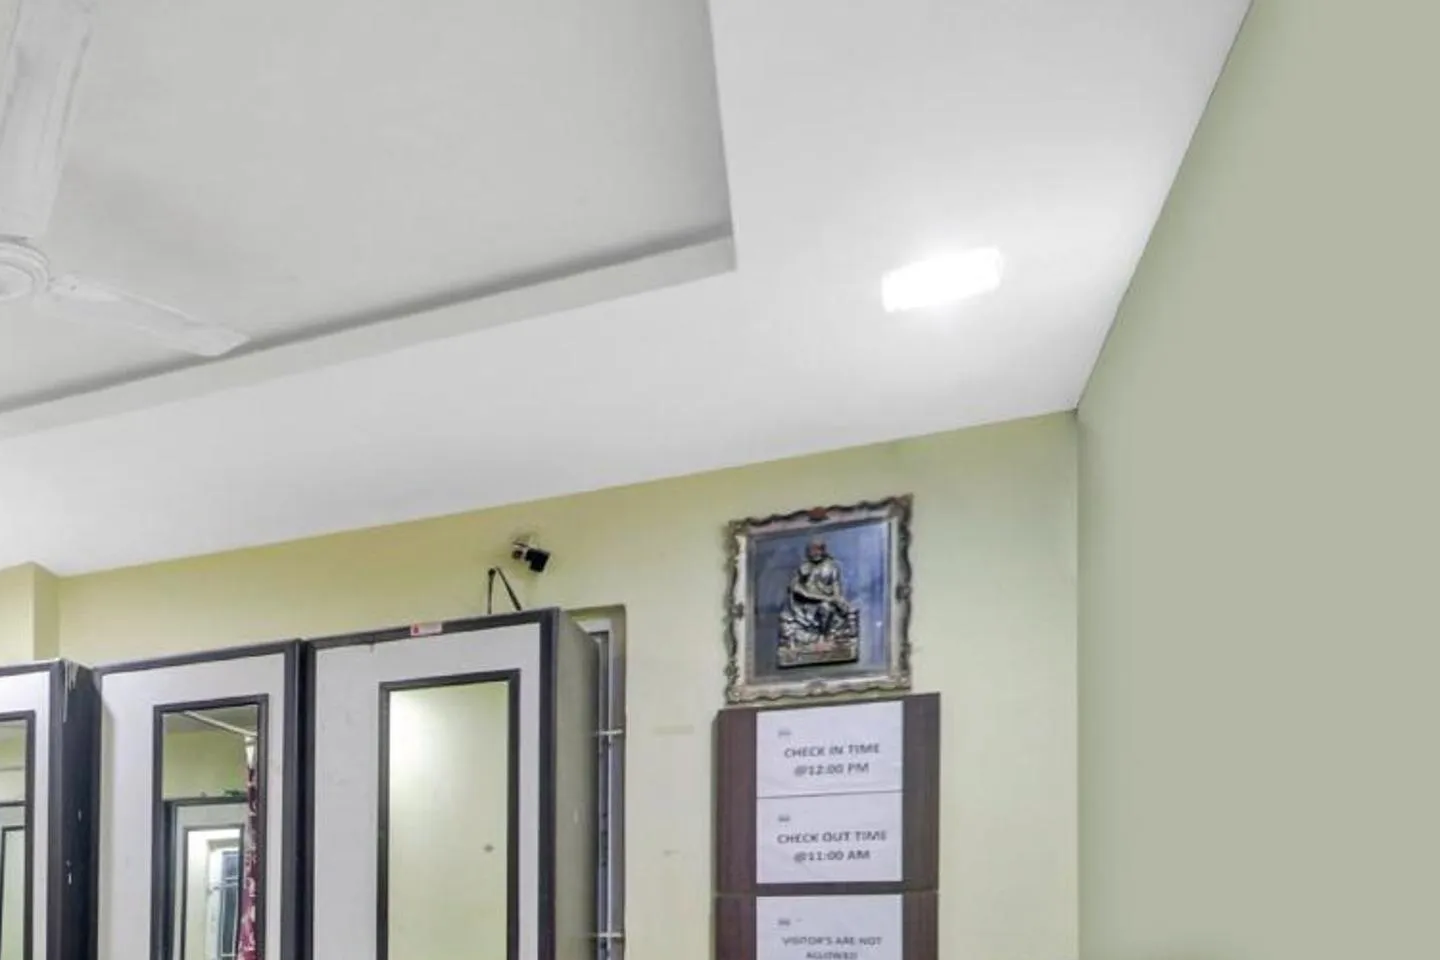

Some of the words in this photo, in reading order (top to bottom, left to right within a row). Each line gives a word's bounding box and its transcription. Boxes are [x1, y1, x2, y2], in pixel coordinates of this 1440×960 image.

[784, 746, 825, 758] CHECK
[829, 745, 843, 755] IN
[848, 743, 879, 754] TIME
[794, 764, 844, 777] @12:00
[848, 762, 869, 774] PM
[777, 832, 819, 844] CHECK
[822, 831, 850, 842] OUT
[856, 830, 887, 841] TIME
[794, 851, 844, 864] @11:00
[848, 850, 870, 861] AM
[835, 936, 855, 945] ARE
[859, 936, 882, 945] NOT
[805, 951, 858, 960] ALLOWED
